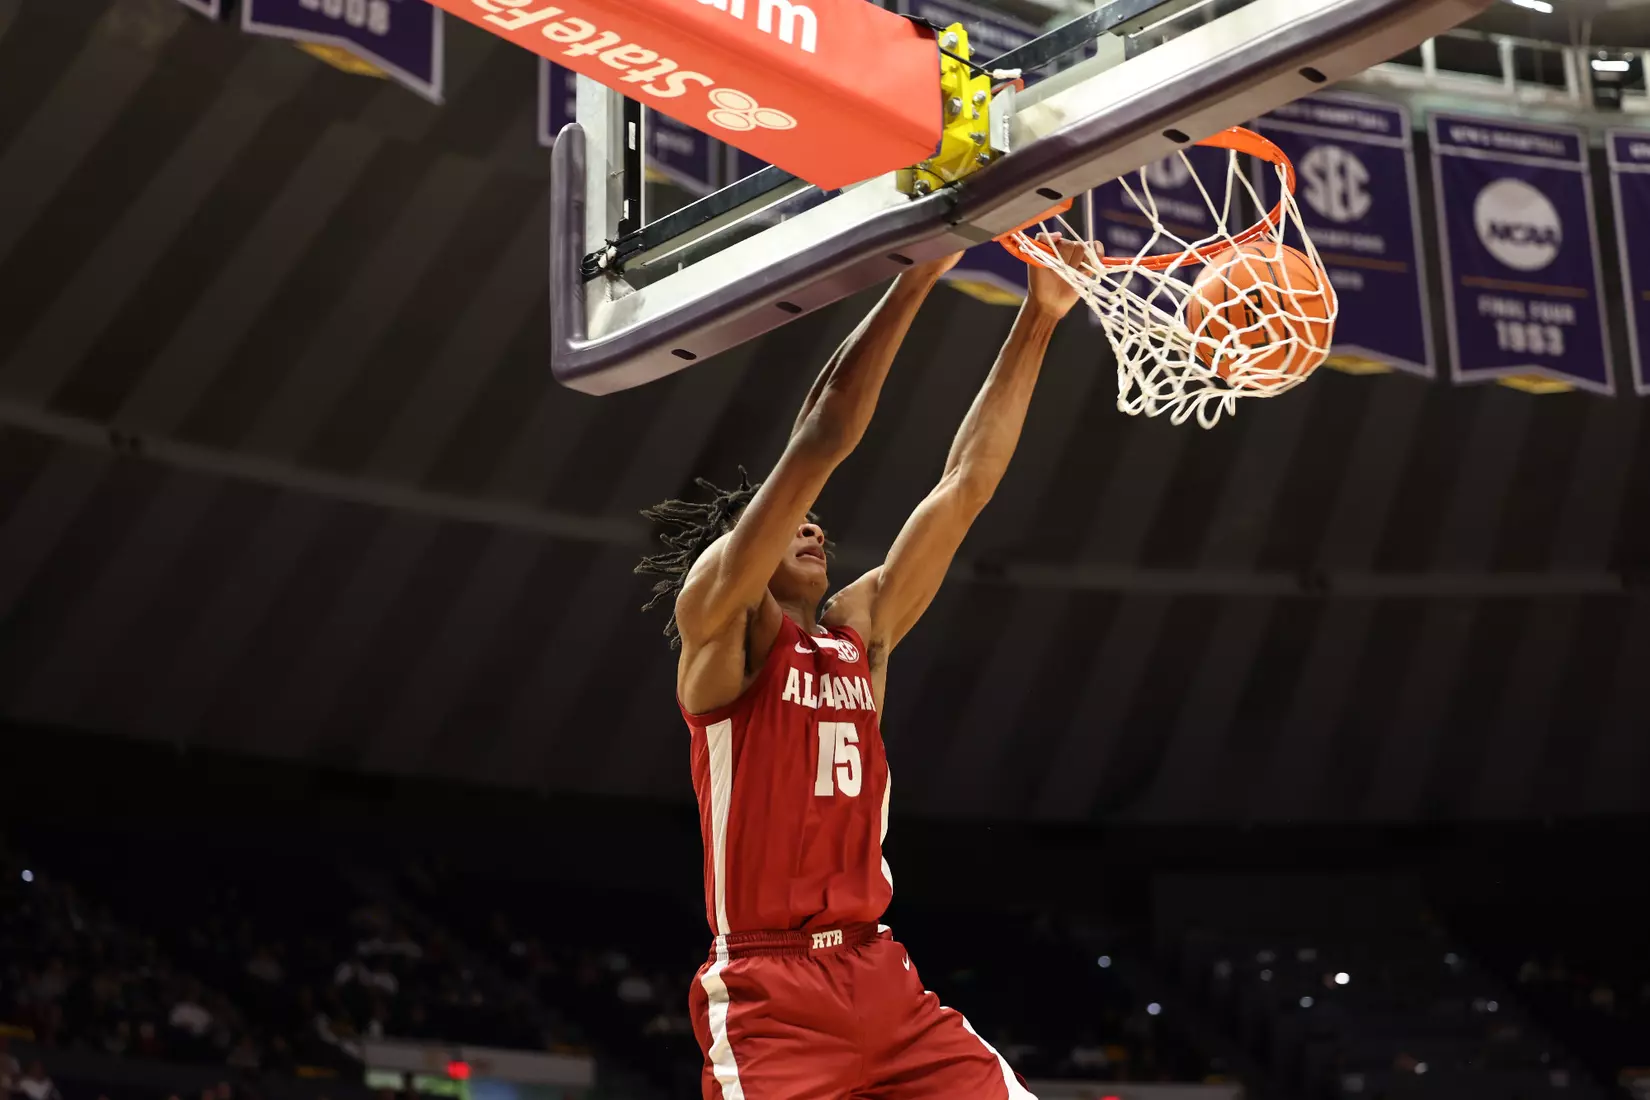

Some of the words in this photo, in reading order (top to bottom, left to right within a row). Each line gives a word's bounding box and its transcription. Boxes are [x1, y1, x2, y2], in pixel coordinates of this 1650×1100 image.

[1299, 145, 1373, 222] SEC
[1485, 219, 1560, 250] NCAA
[782, 667, 876, 712] ALAAMA
[814, 721, 862, 797] 15
[812, 929, 843, 949] RTR
